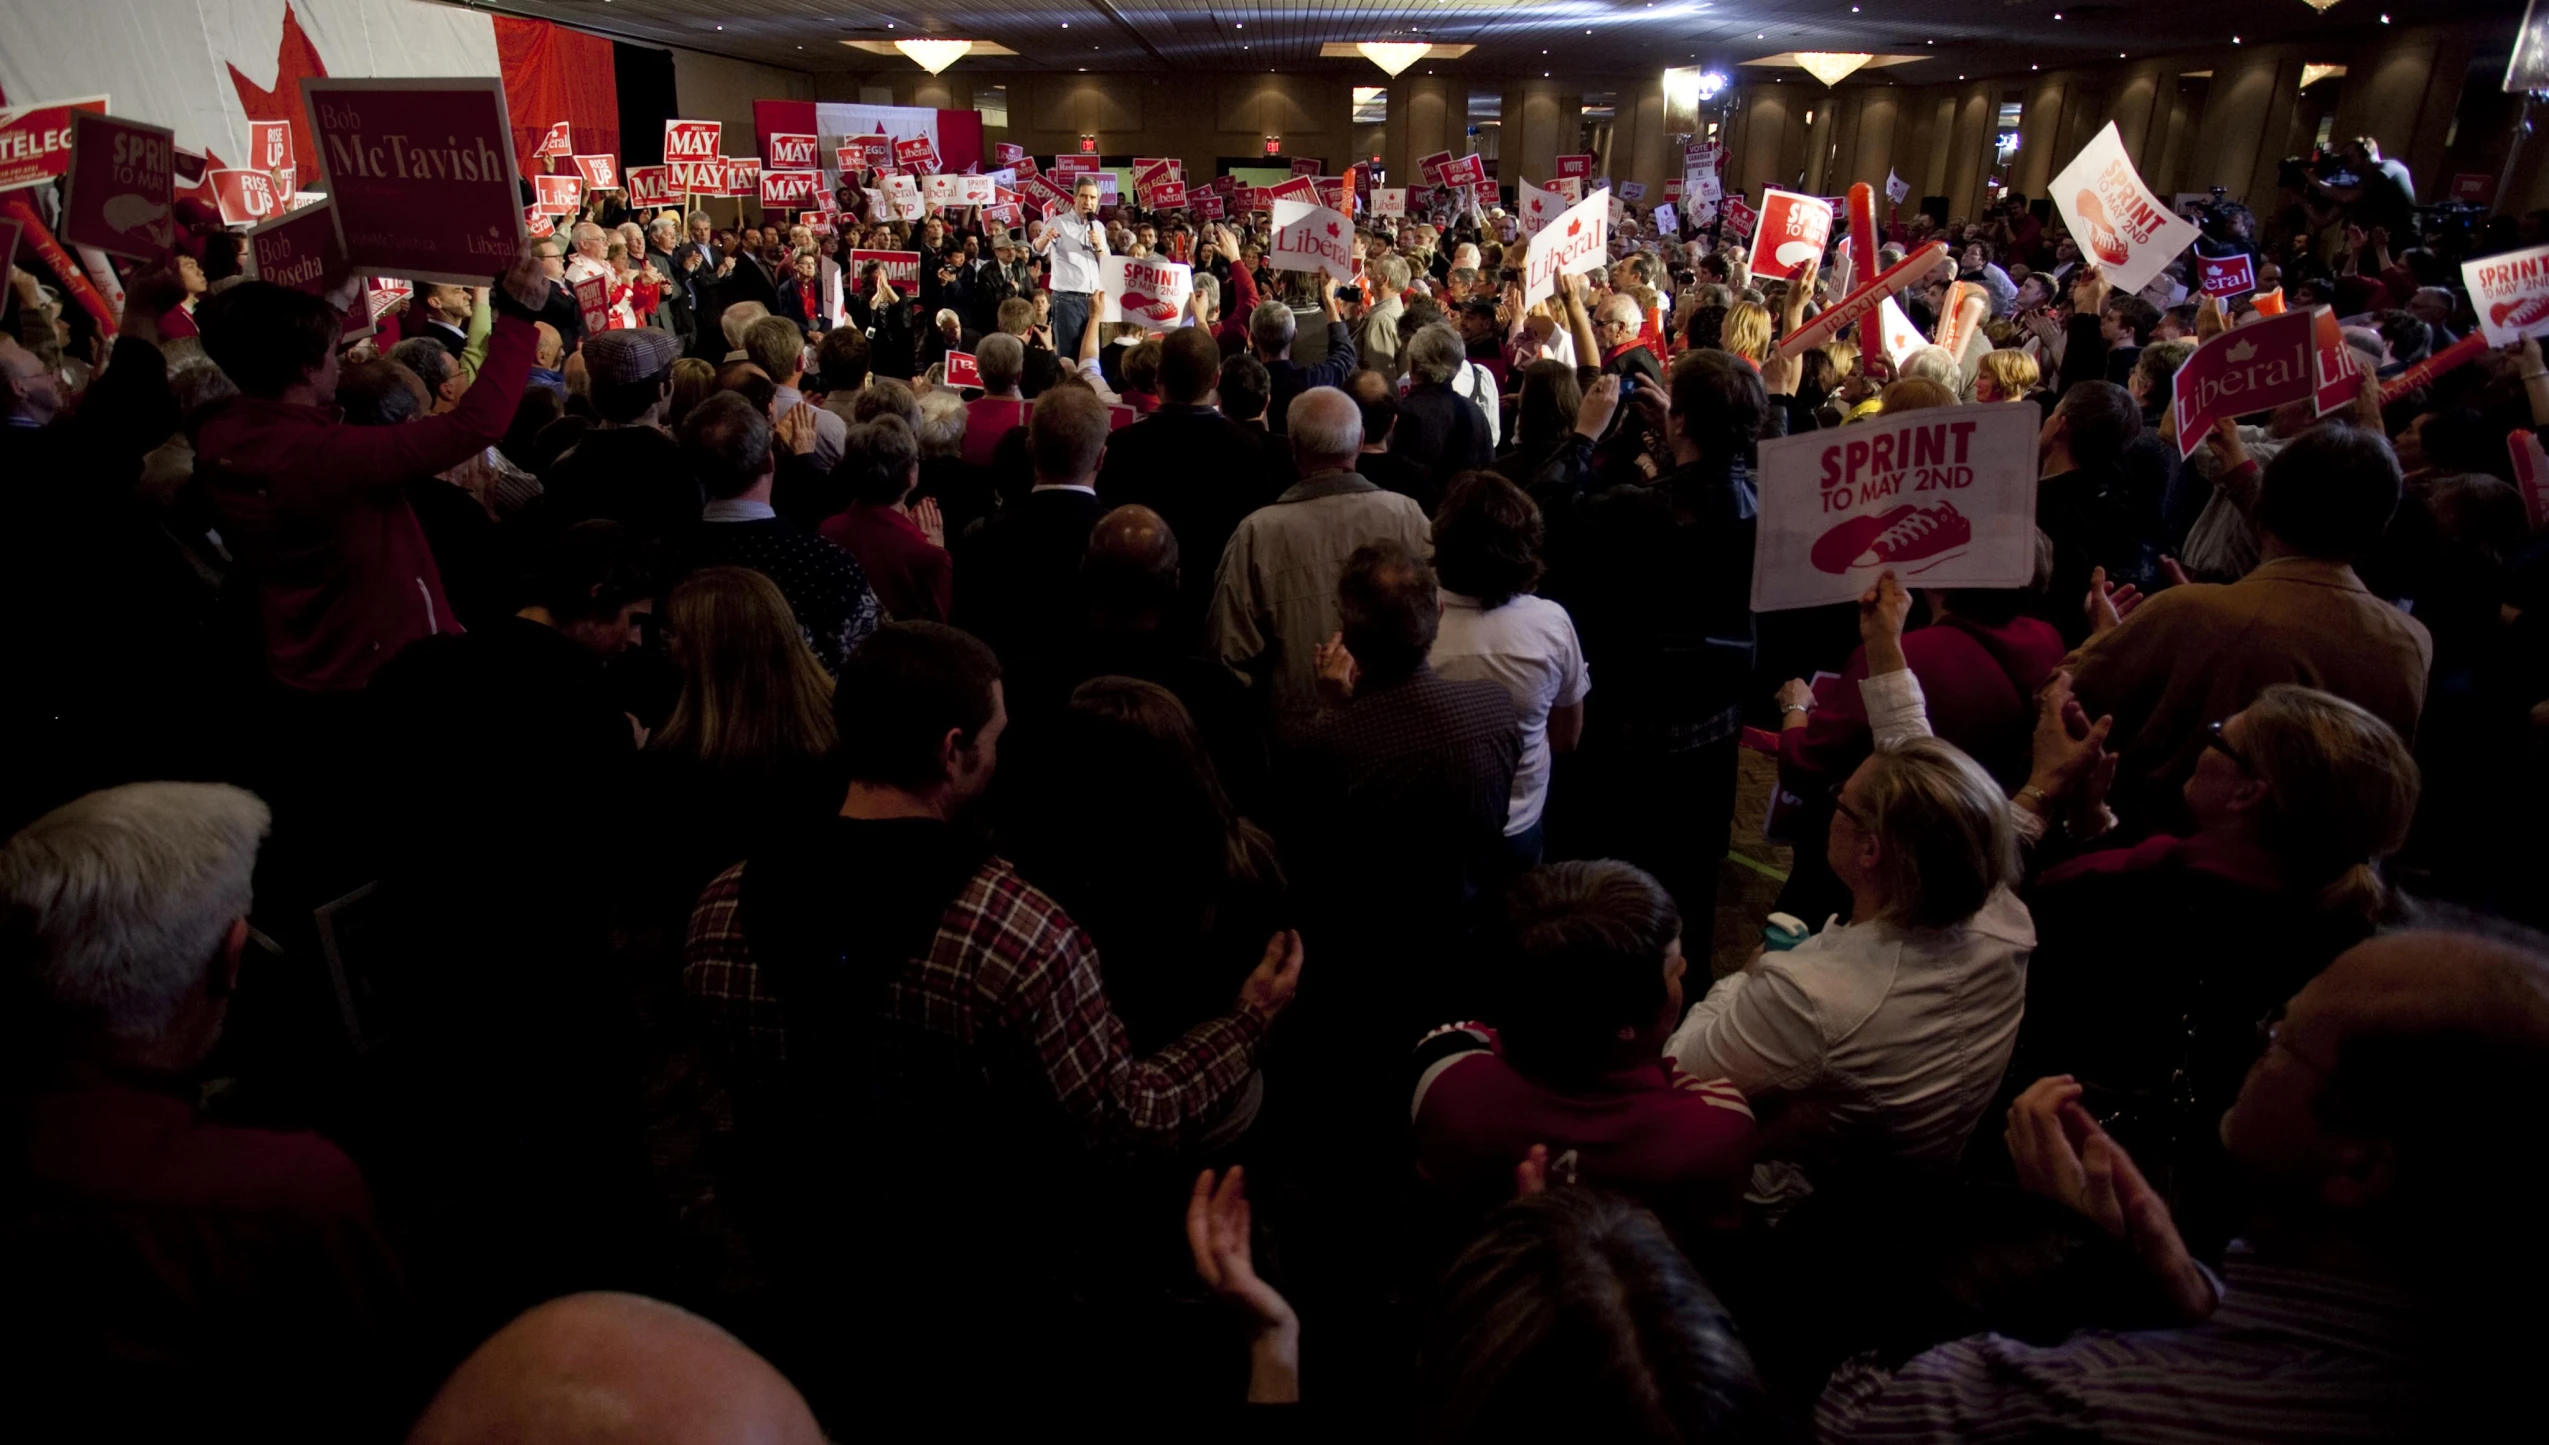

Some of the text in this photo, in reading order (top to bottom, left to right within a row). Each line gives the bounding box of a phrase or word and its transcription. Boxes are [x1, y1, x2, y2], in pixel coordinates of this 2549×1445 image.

[320, 103, 361, 130] Bob
[266, 128, 283, 142] RISE
[668, 131, 719, 155] MAY
[1082, 140, 1095, 150] EXIT
[266, 142, 284, 167] UP
[773, 141, 815, 162] MAY
[1266, 141, 1279, 152] EXIT
[1688, 143, 1709, 153] VOTE
[327, 134, 503, 182] McTavish
[588, 158, 608, 170] RISE
[1059, 163, 1090, 171] Redman
[1563, 160, 1584, 173] VOTE
[112, 164, 164, 192] TO MAY
[240, 174, 269, 193] RISE
[592, 168, 613, 185] UP
[670, 163, 727, 189] MAY
[763, 180, 812, 202] MAY
[2104, 157, 2167, 235] SPRINT
[243, 189, 274, 216] UP
[992, 207, 1010, 219] RISE
[2097, 173, 2149, 245] TO MAY 2ND
[1786, 223, 1801, 237] TO
[258, 231, 291, 265] Bob
[853, 259, 918, 282] RMAN
[1123, 263, 1181, 287] SPRINT
[1124, 278, 1180, 297] TO MAY 2ND
[2483, 286, 2494, 300] TO
[2495, 282, 2518, 298] MAY
[1823, 283, 1894, 335] Liberal
[1820, 421, 1977, 489] SPRINT
[1821, 466, 1974, 513] TO MAY 2ND
